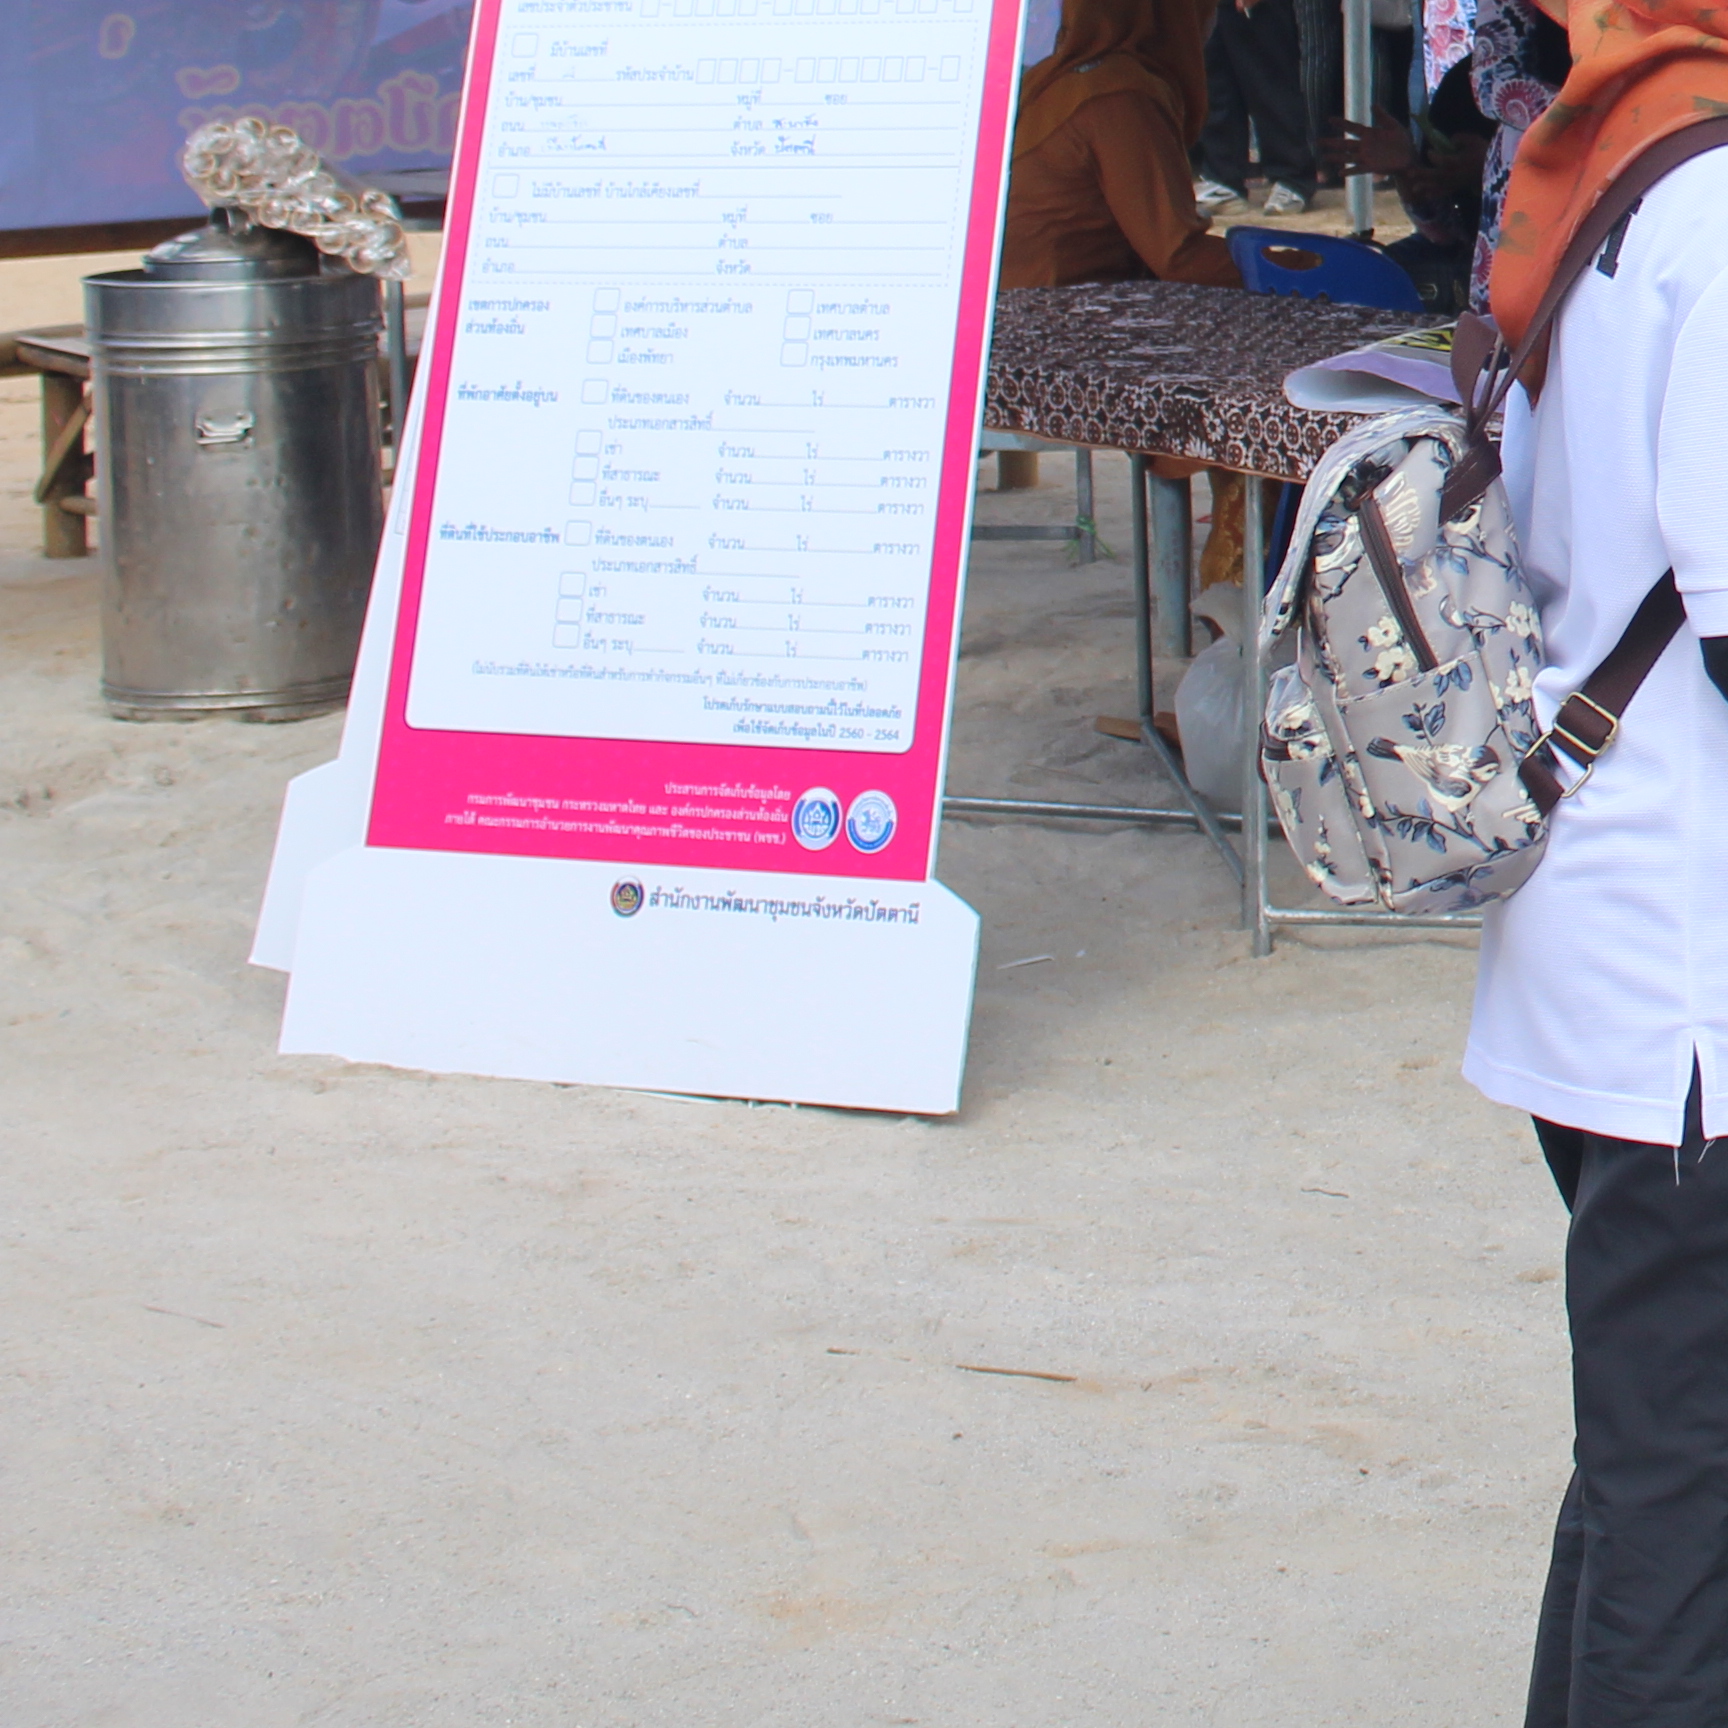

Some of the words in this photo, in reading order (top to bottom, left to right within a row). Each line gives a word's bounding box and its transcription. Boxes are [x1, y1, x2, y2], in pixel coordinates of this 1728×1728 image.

[839, 726, 865, 739] 2560
[874, 728, 900, 741] 2564
[649, 884, 920, 925] สำนักงานพัฒนาชุมชนจังหวัดปัตตานี
